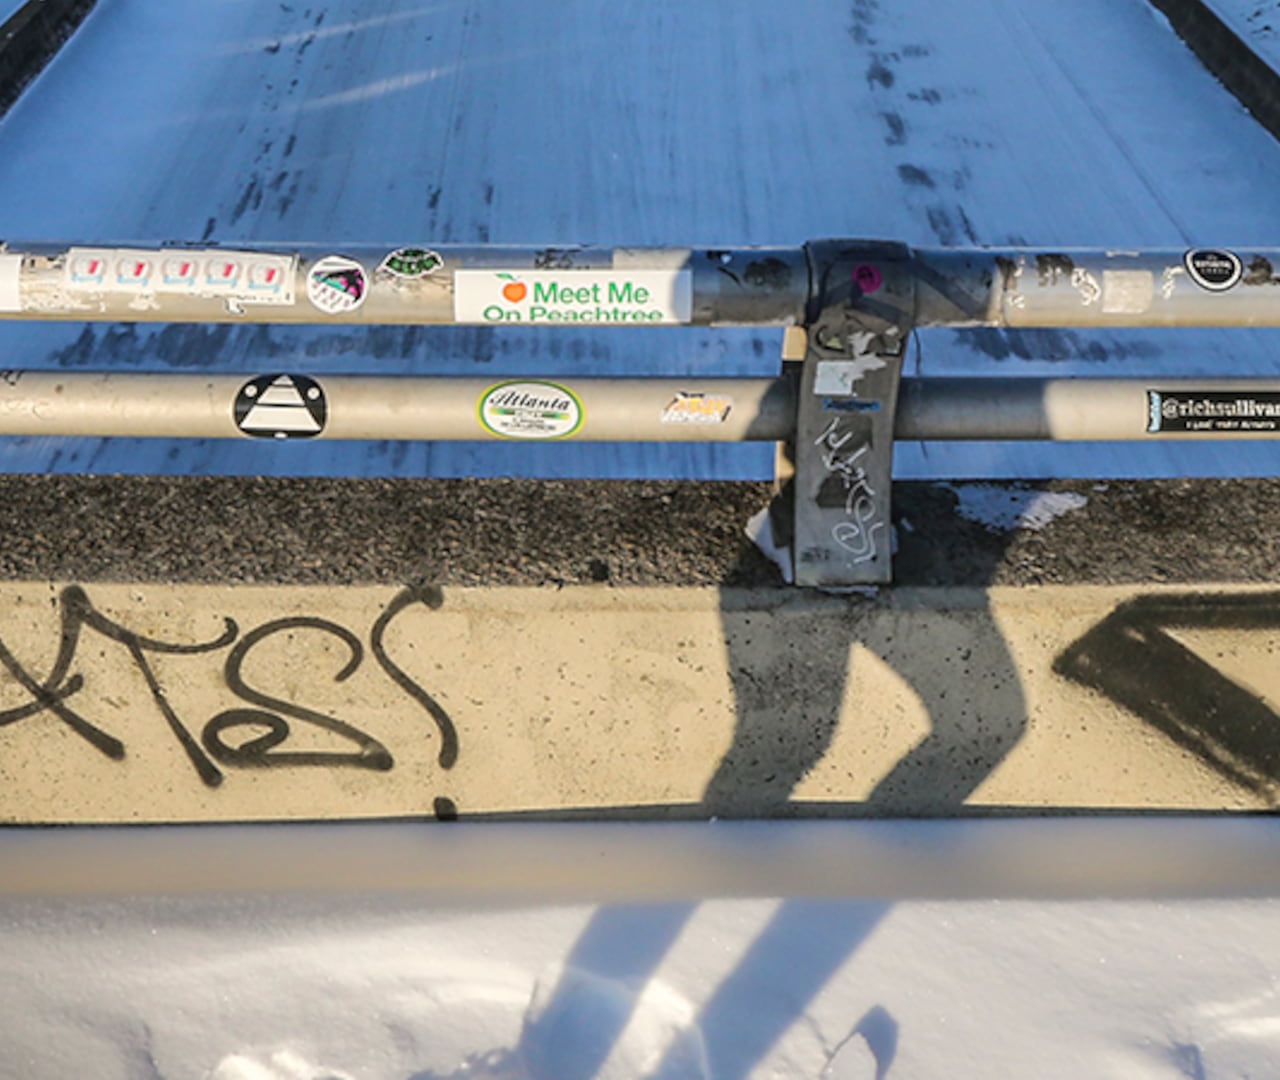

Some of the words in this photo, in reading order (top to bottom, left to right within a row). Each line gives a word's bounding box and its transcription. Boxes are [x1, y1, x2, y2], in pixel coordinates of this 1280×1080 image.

[533, 281, 601, 304] Meet
[608, 281, 649, 304] Me
[482, 305, 523, 321] On
[529, 306, 664, 321] Peachtree
[489, 391, 570, 411] Atlanta
